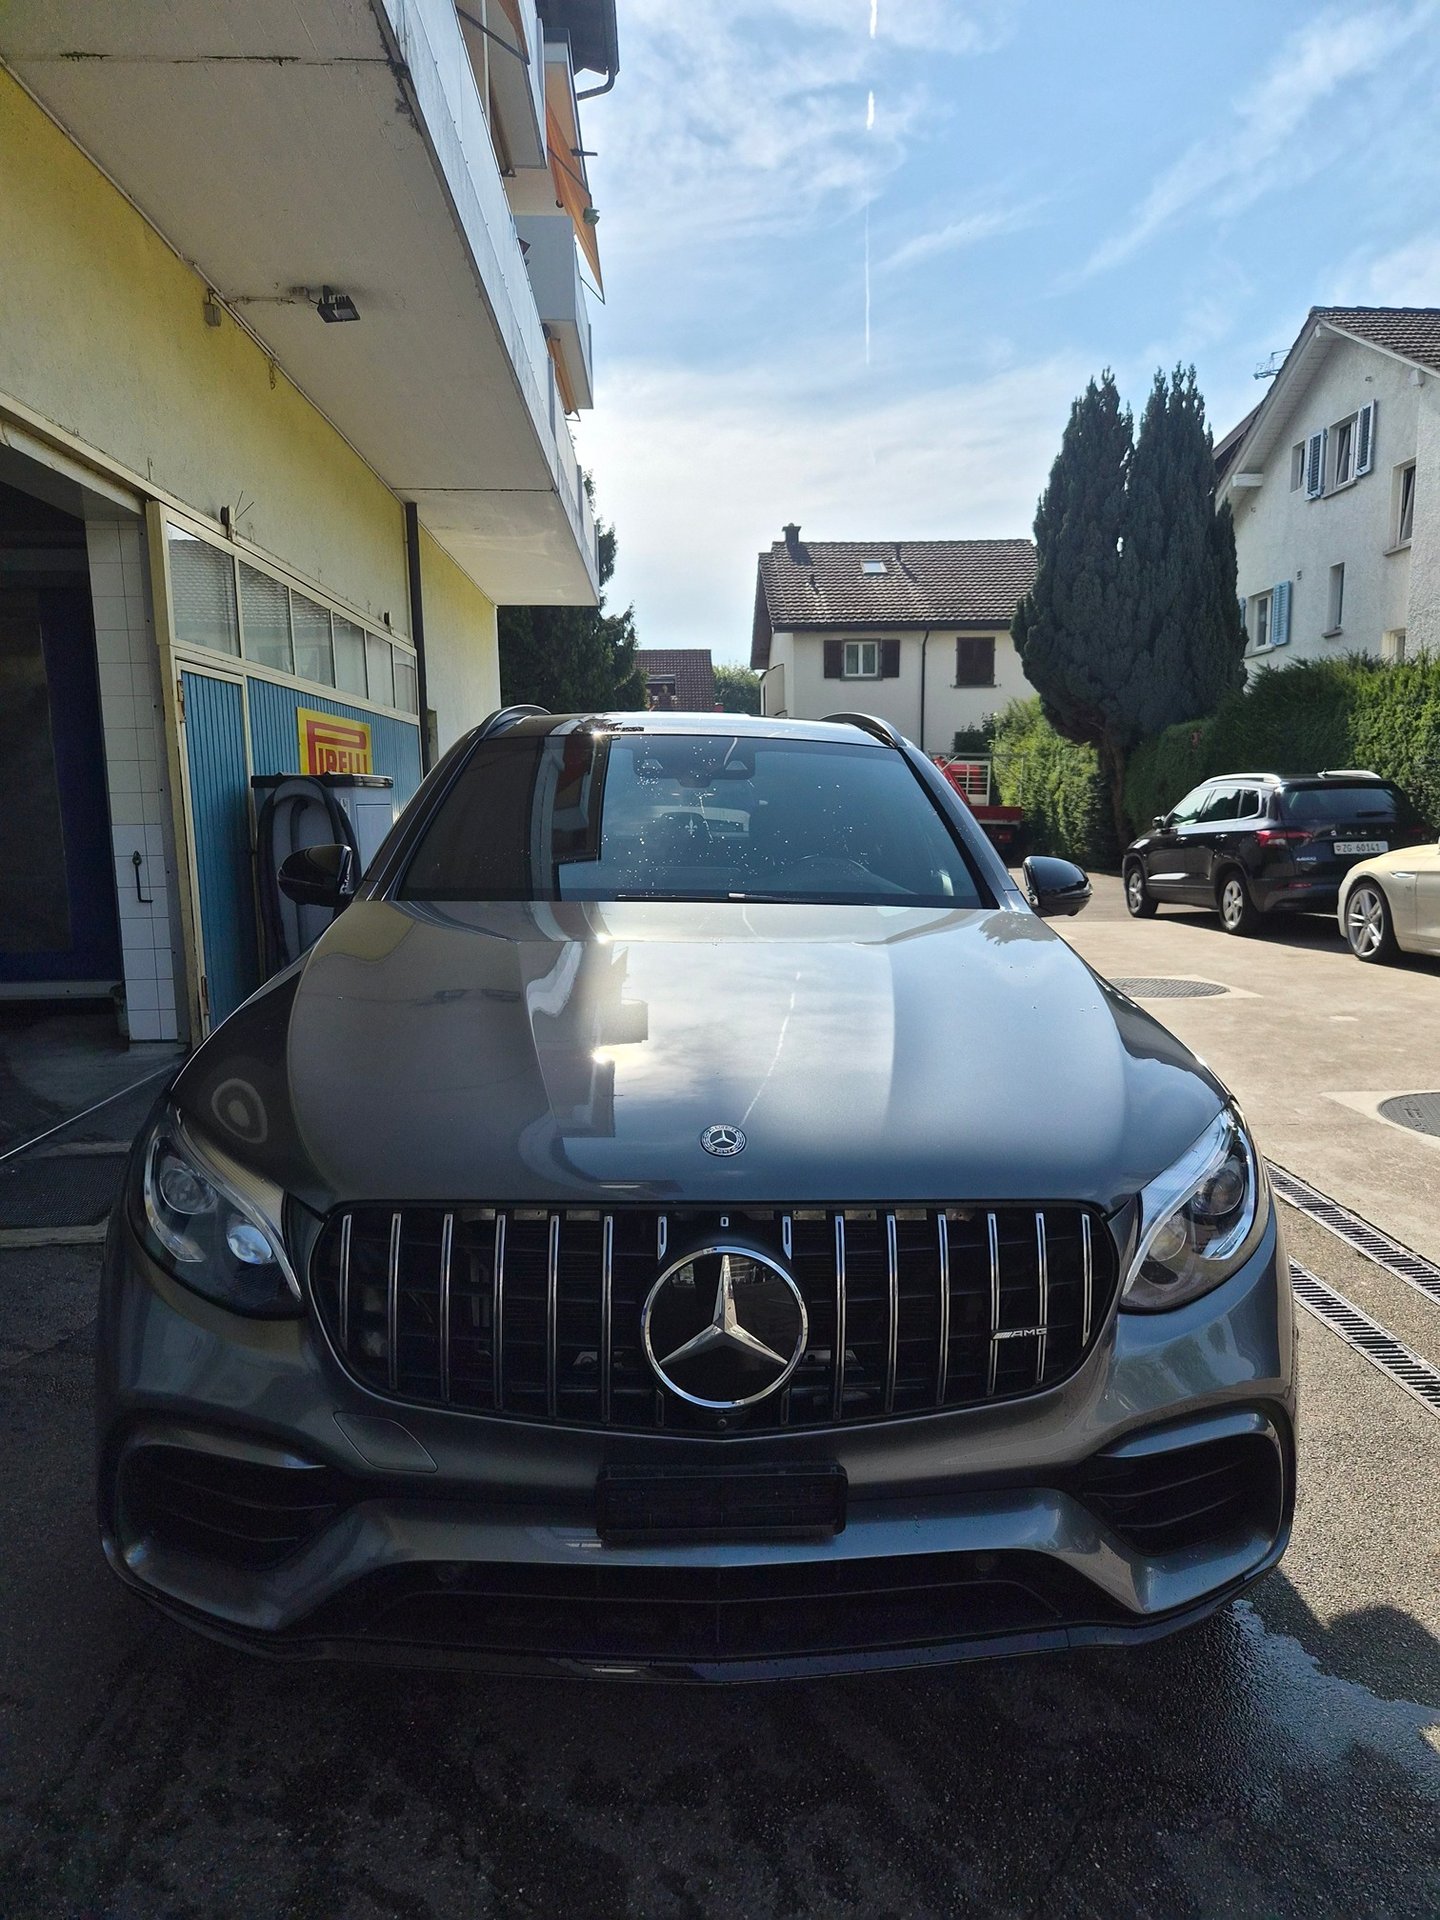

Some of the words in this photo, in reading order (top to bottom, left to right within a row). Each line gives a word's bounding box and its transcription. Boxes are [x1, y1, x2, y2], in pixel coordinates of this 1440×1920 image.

[306, 720, 368, 775] PIRELLI
[1342, 843, 1353, 853] ZG
[1011, 1328, 1047, 1338] AMG
